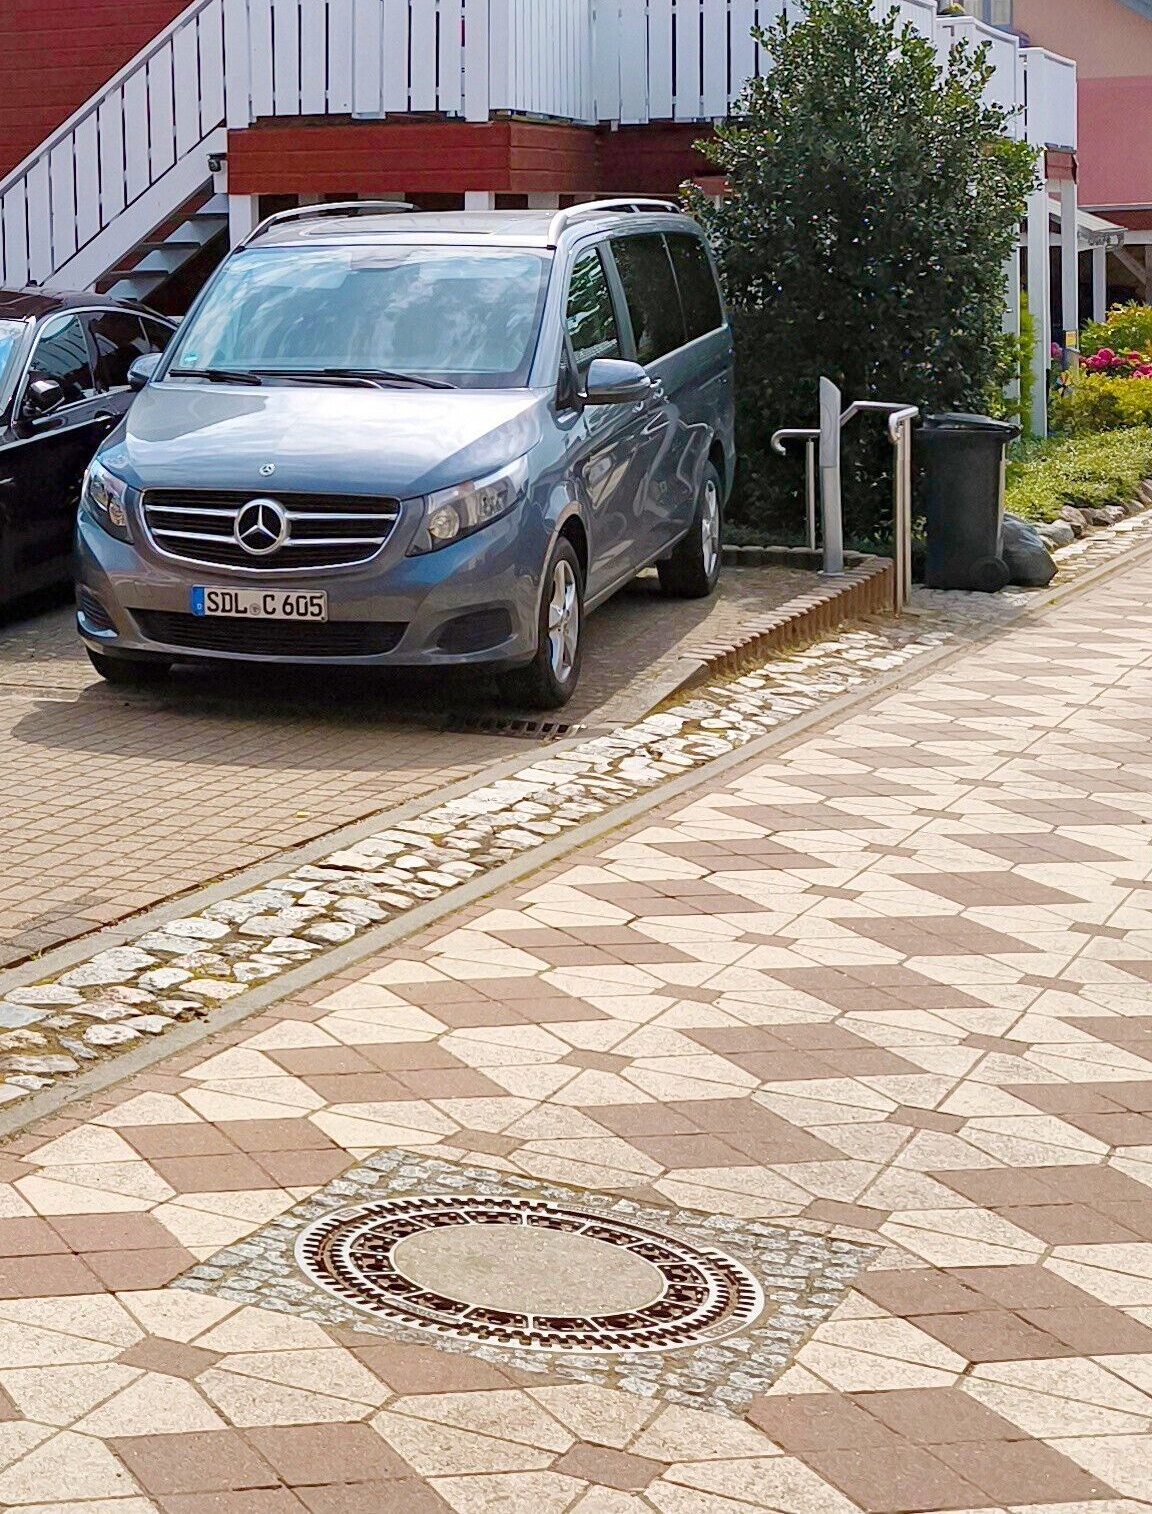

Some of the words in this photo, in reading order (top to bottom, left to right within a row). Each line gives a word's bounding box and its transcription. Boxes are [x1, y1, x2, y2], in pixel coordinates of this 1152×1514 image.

[206, 591, 248, 614] SDL
[262, 594, 277, 615] C
[282, 594, 324, 617] 605
